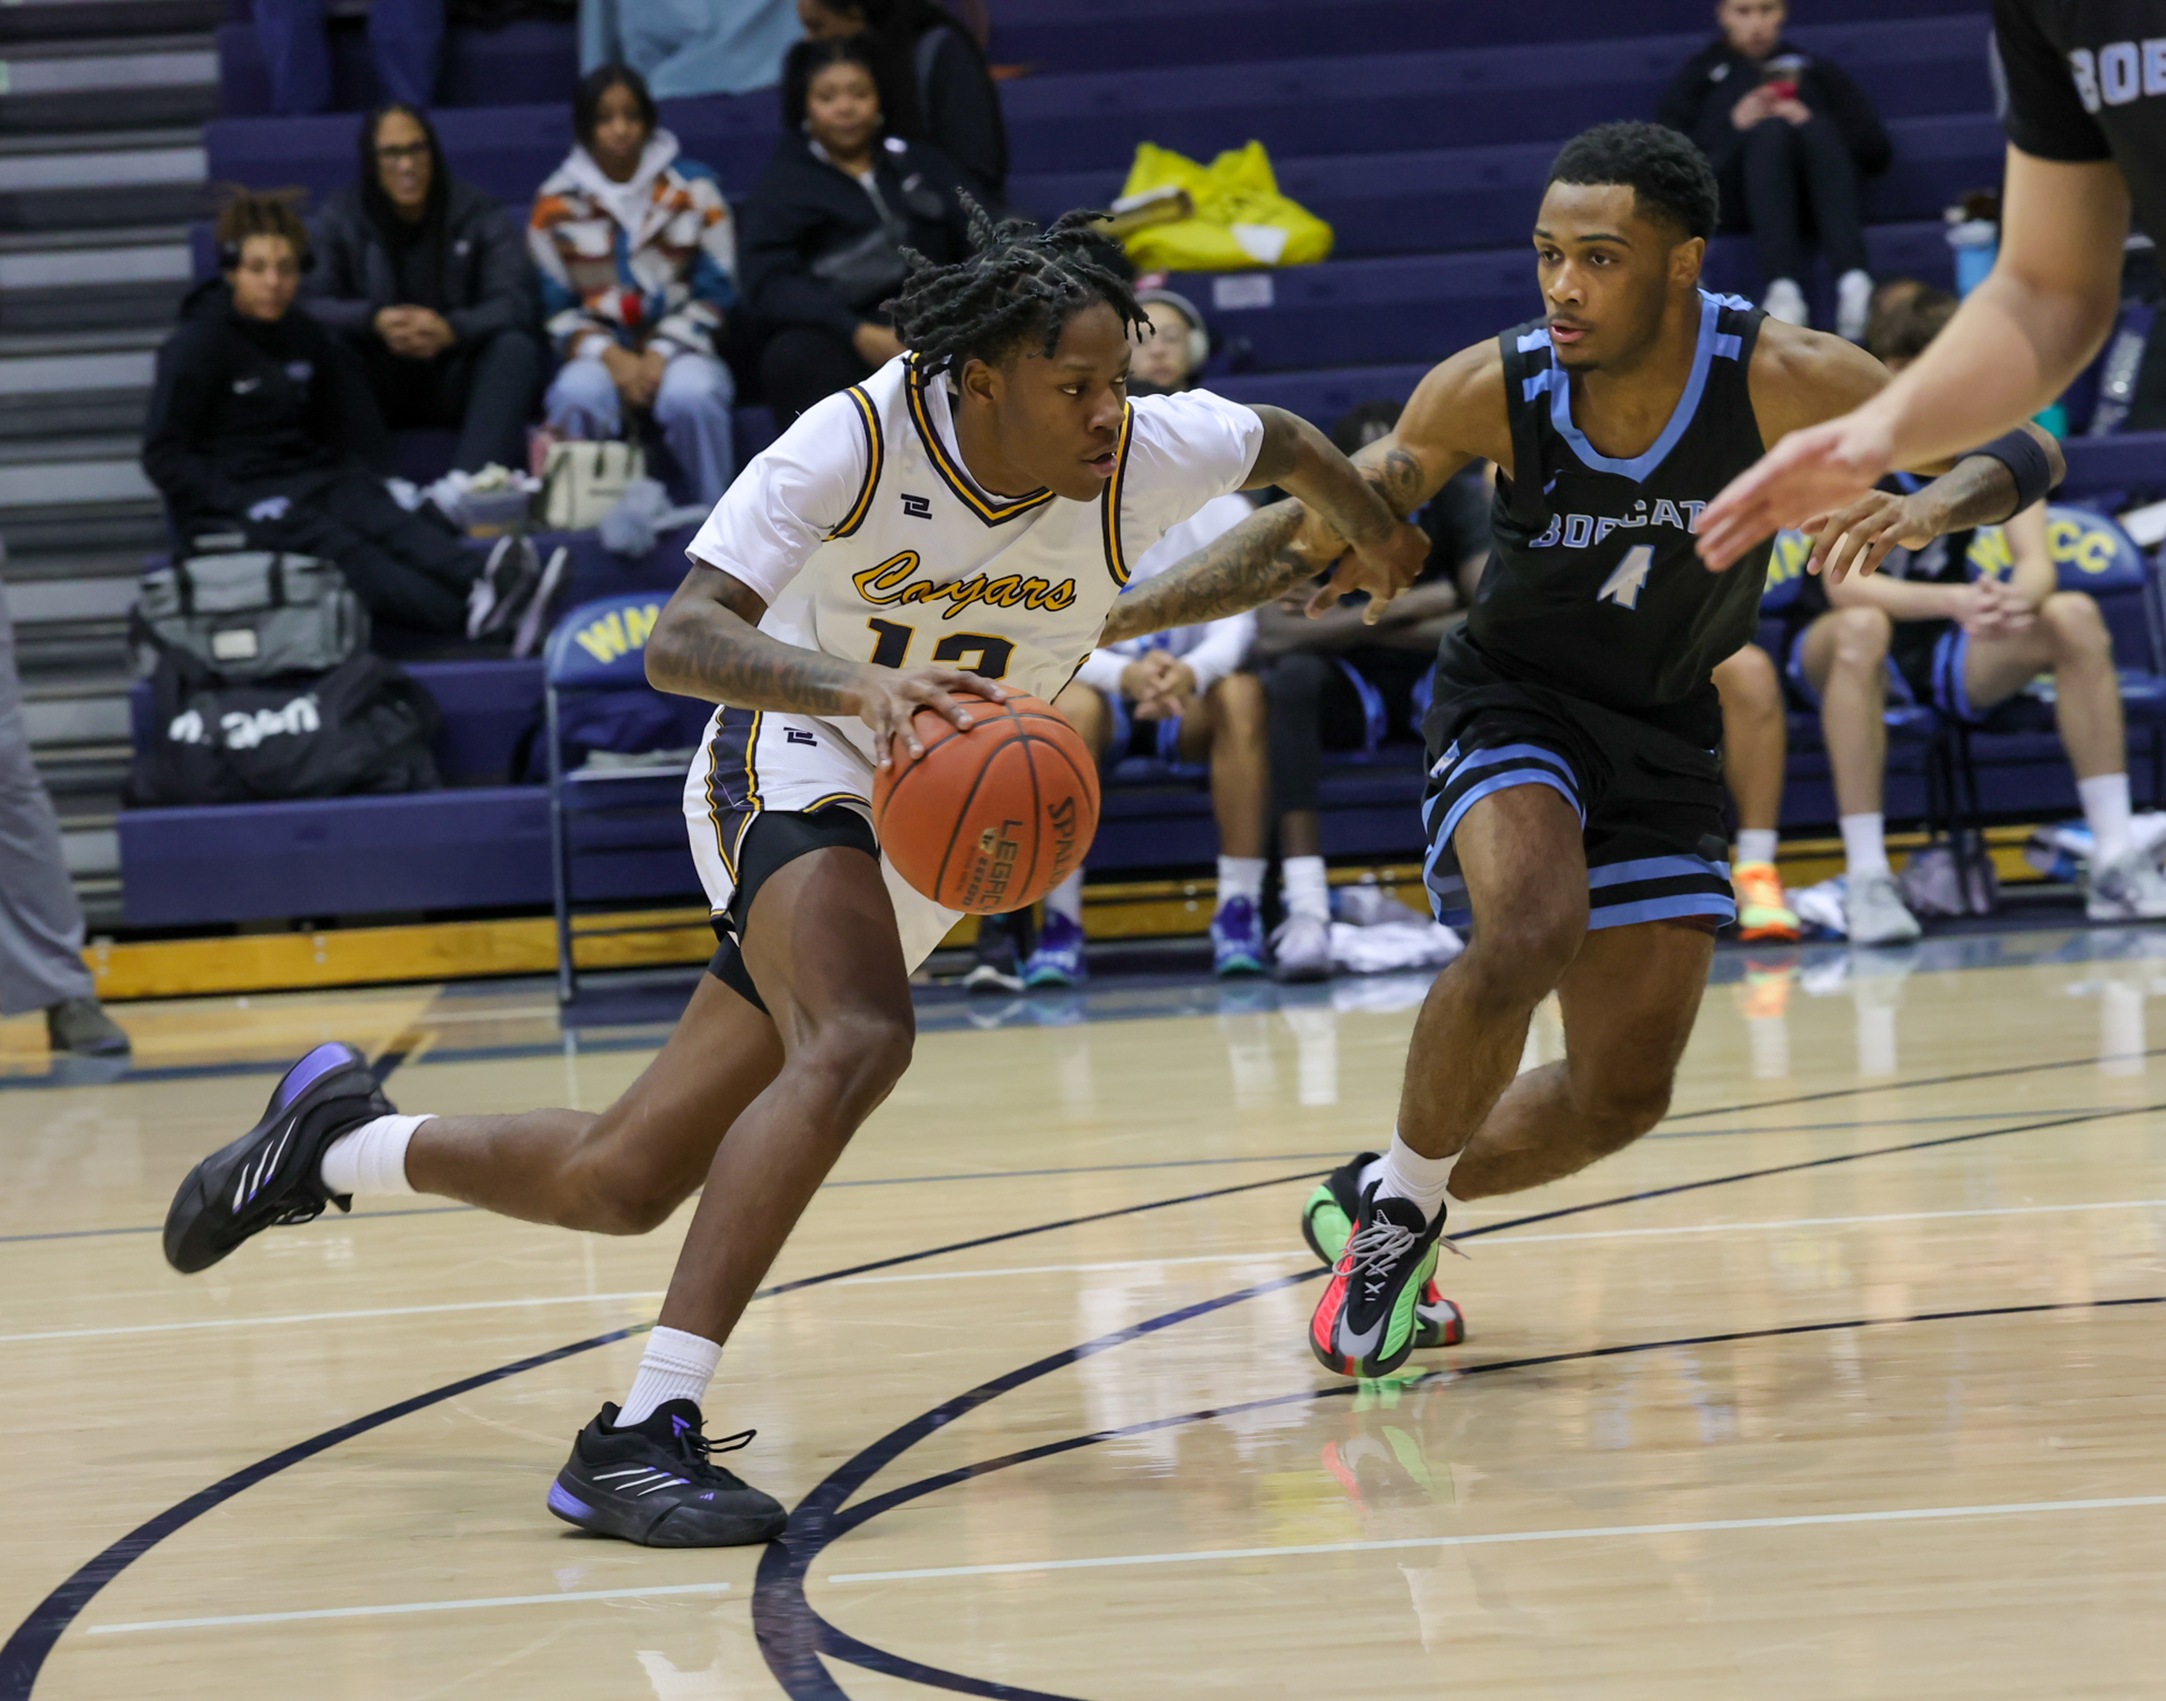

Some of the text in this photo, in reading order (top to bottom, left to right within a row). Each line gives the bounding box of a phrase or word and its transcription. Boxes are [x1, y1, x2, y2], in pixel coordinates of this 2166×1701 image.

[1529, 498, 1709, 549] BOBCAT
[1966, 521, 2116, 574] WCC
[852, 549, 1077, 620] Cogars
[576, 603, 661, 663] WN
[976, 819, 1024, 912] LEGACY
